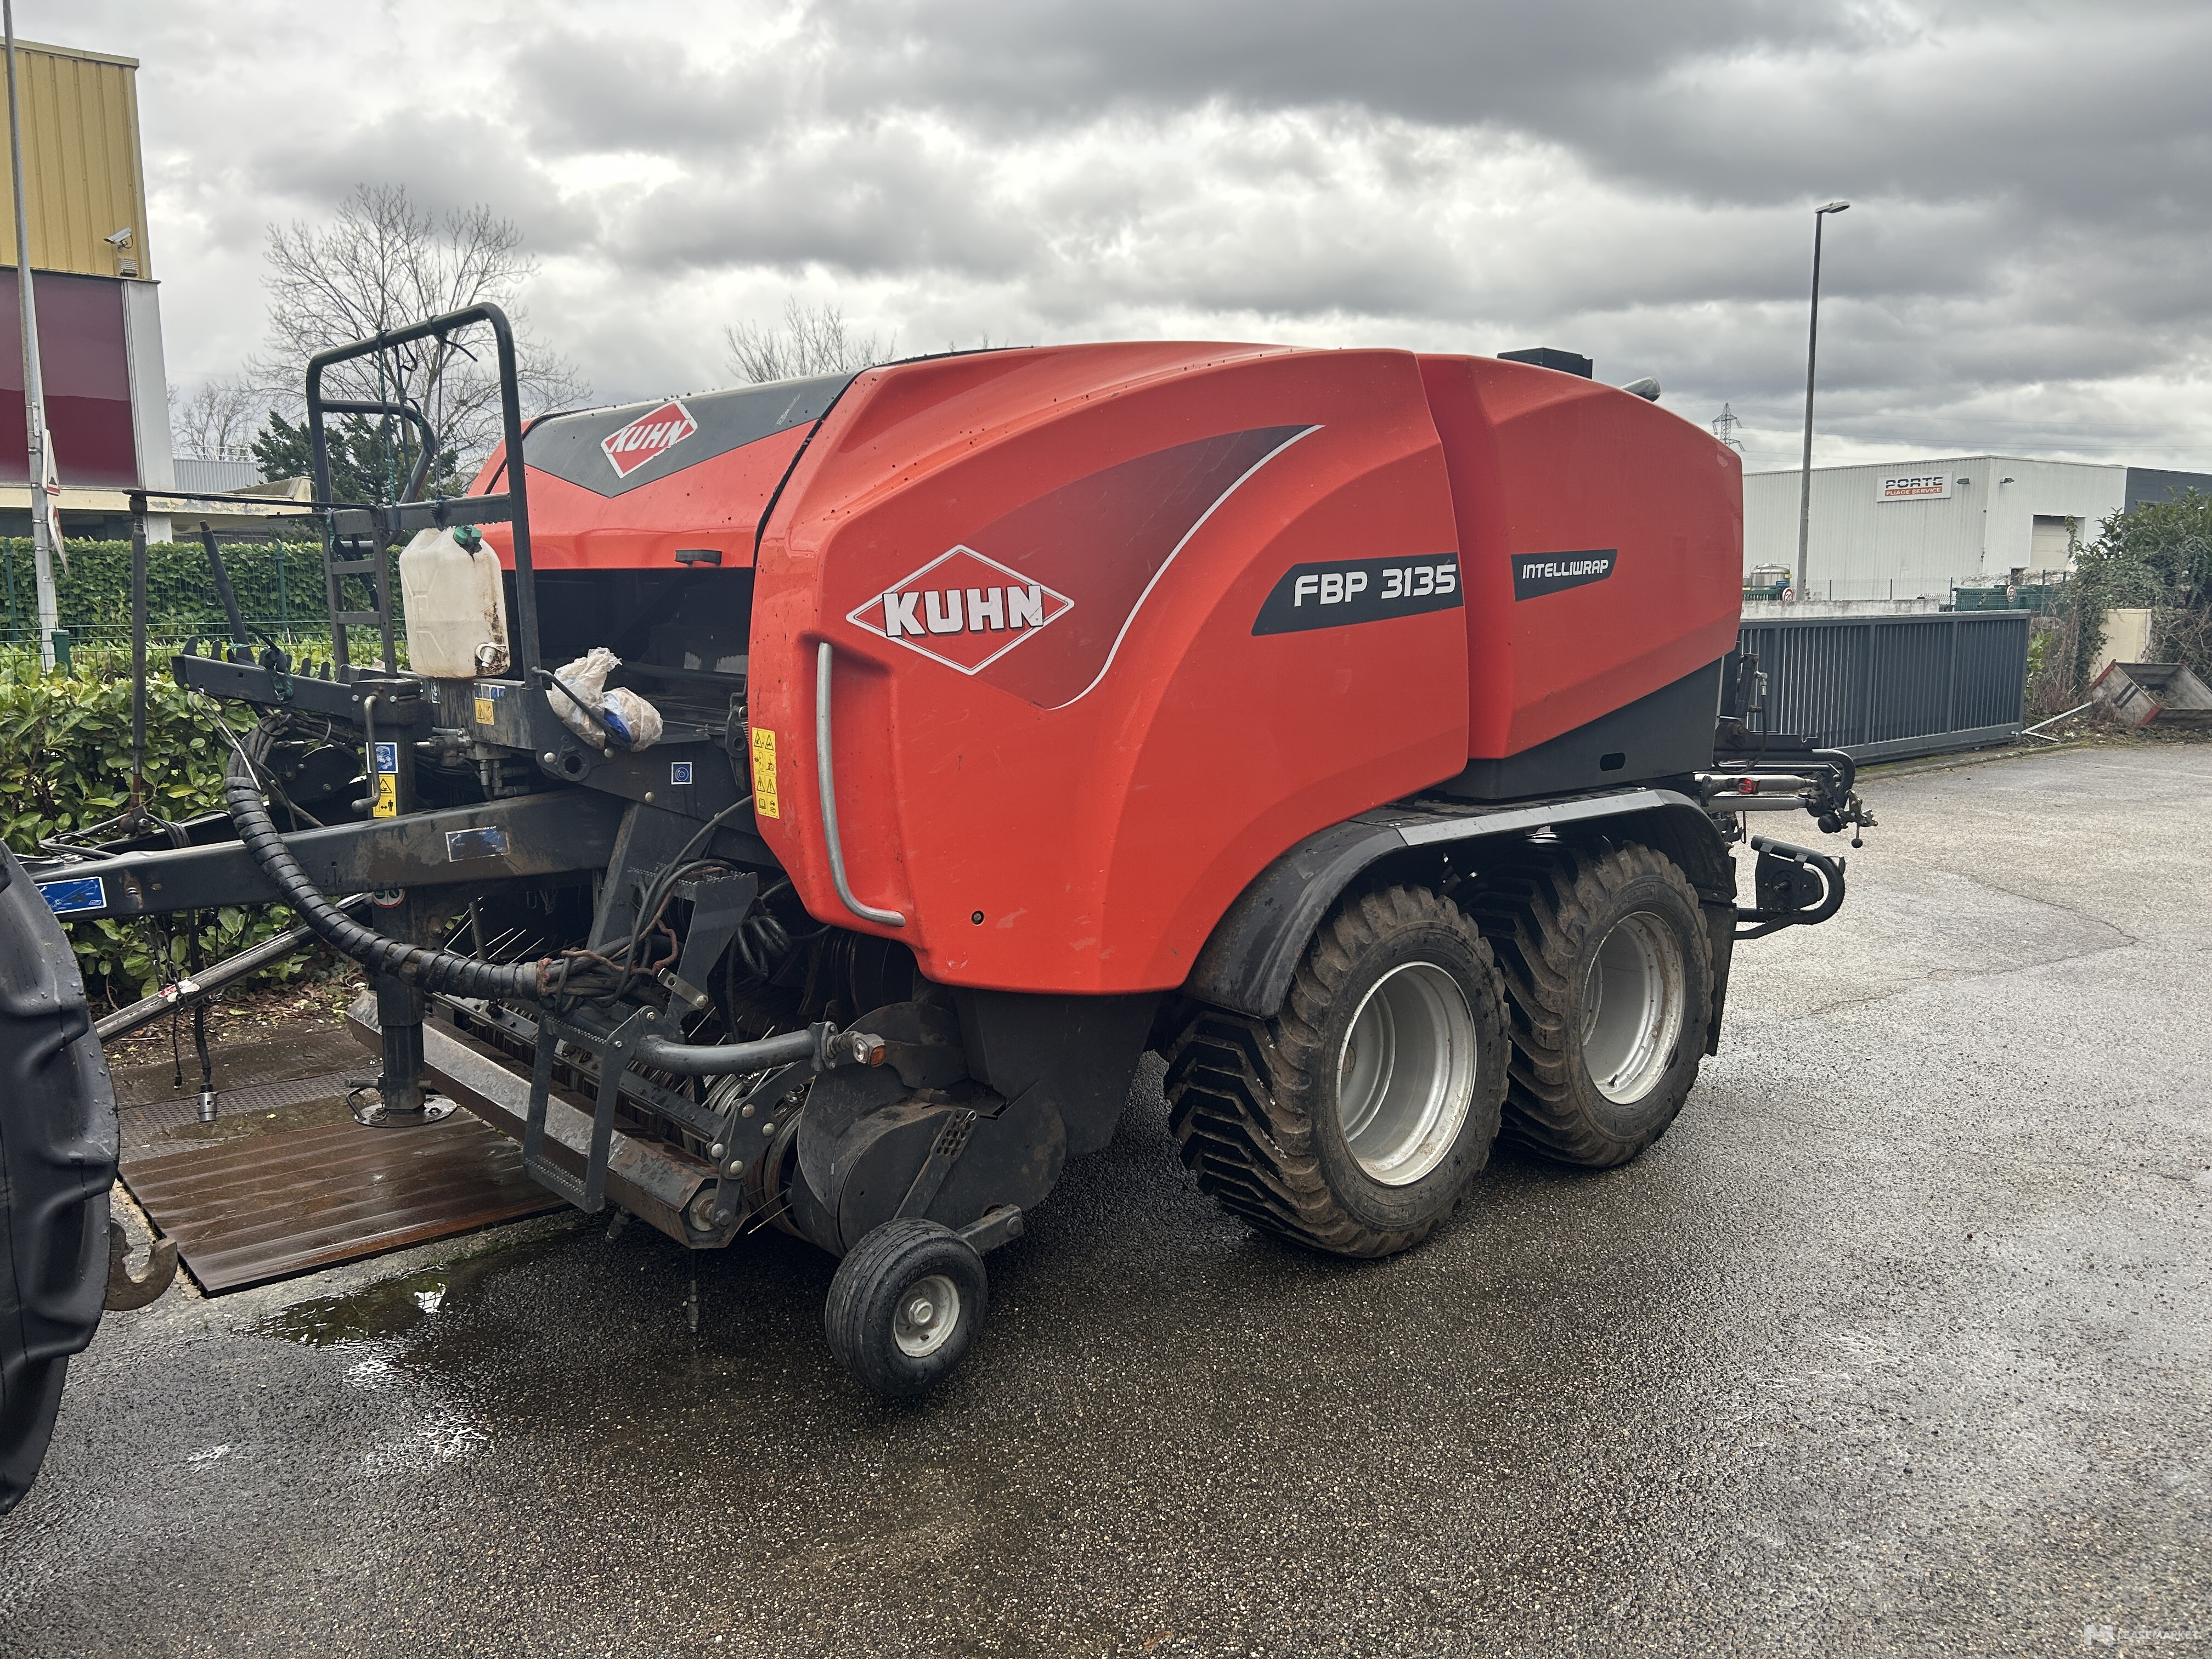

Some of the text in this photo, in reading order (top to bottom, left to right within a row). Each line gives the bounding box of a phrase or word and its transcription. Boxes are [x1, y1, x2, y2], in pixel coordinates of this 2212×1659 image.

[607, 418, 691, 454] KUHN
[1886, 476, 1943, 489] PORTE
[1294, 564, 1456, 607] FBP 3135
[1522, 560, 1609, 579] INTELLIWRAP
[883, 584, 1044, 637] KUHN
